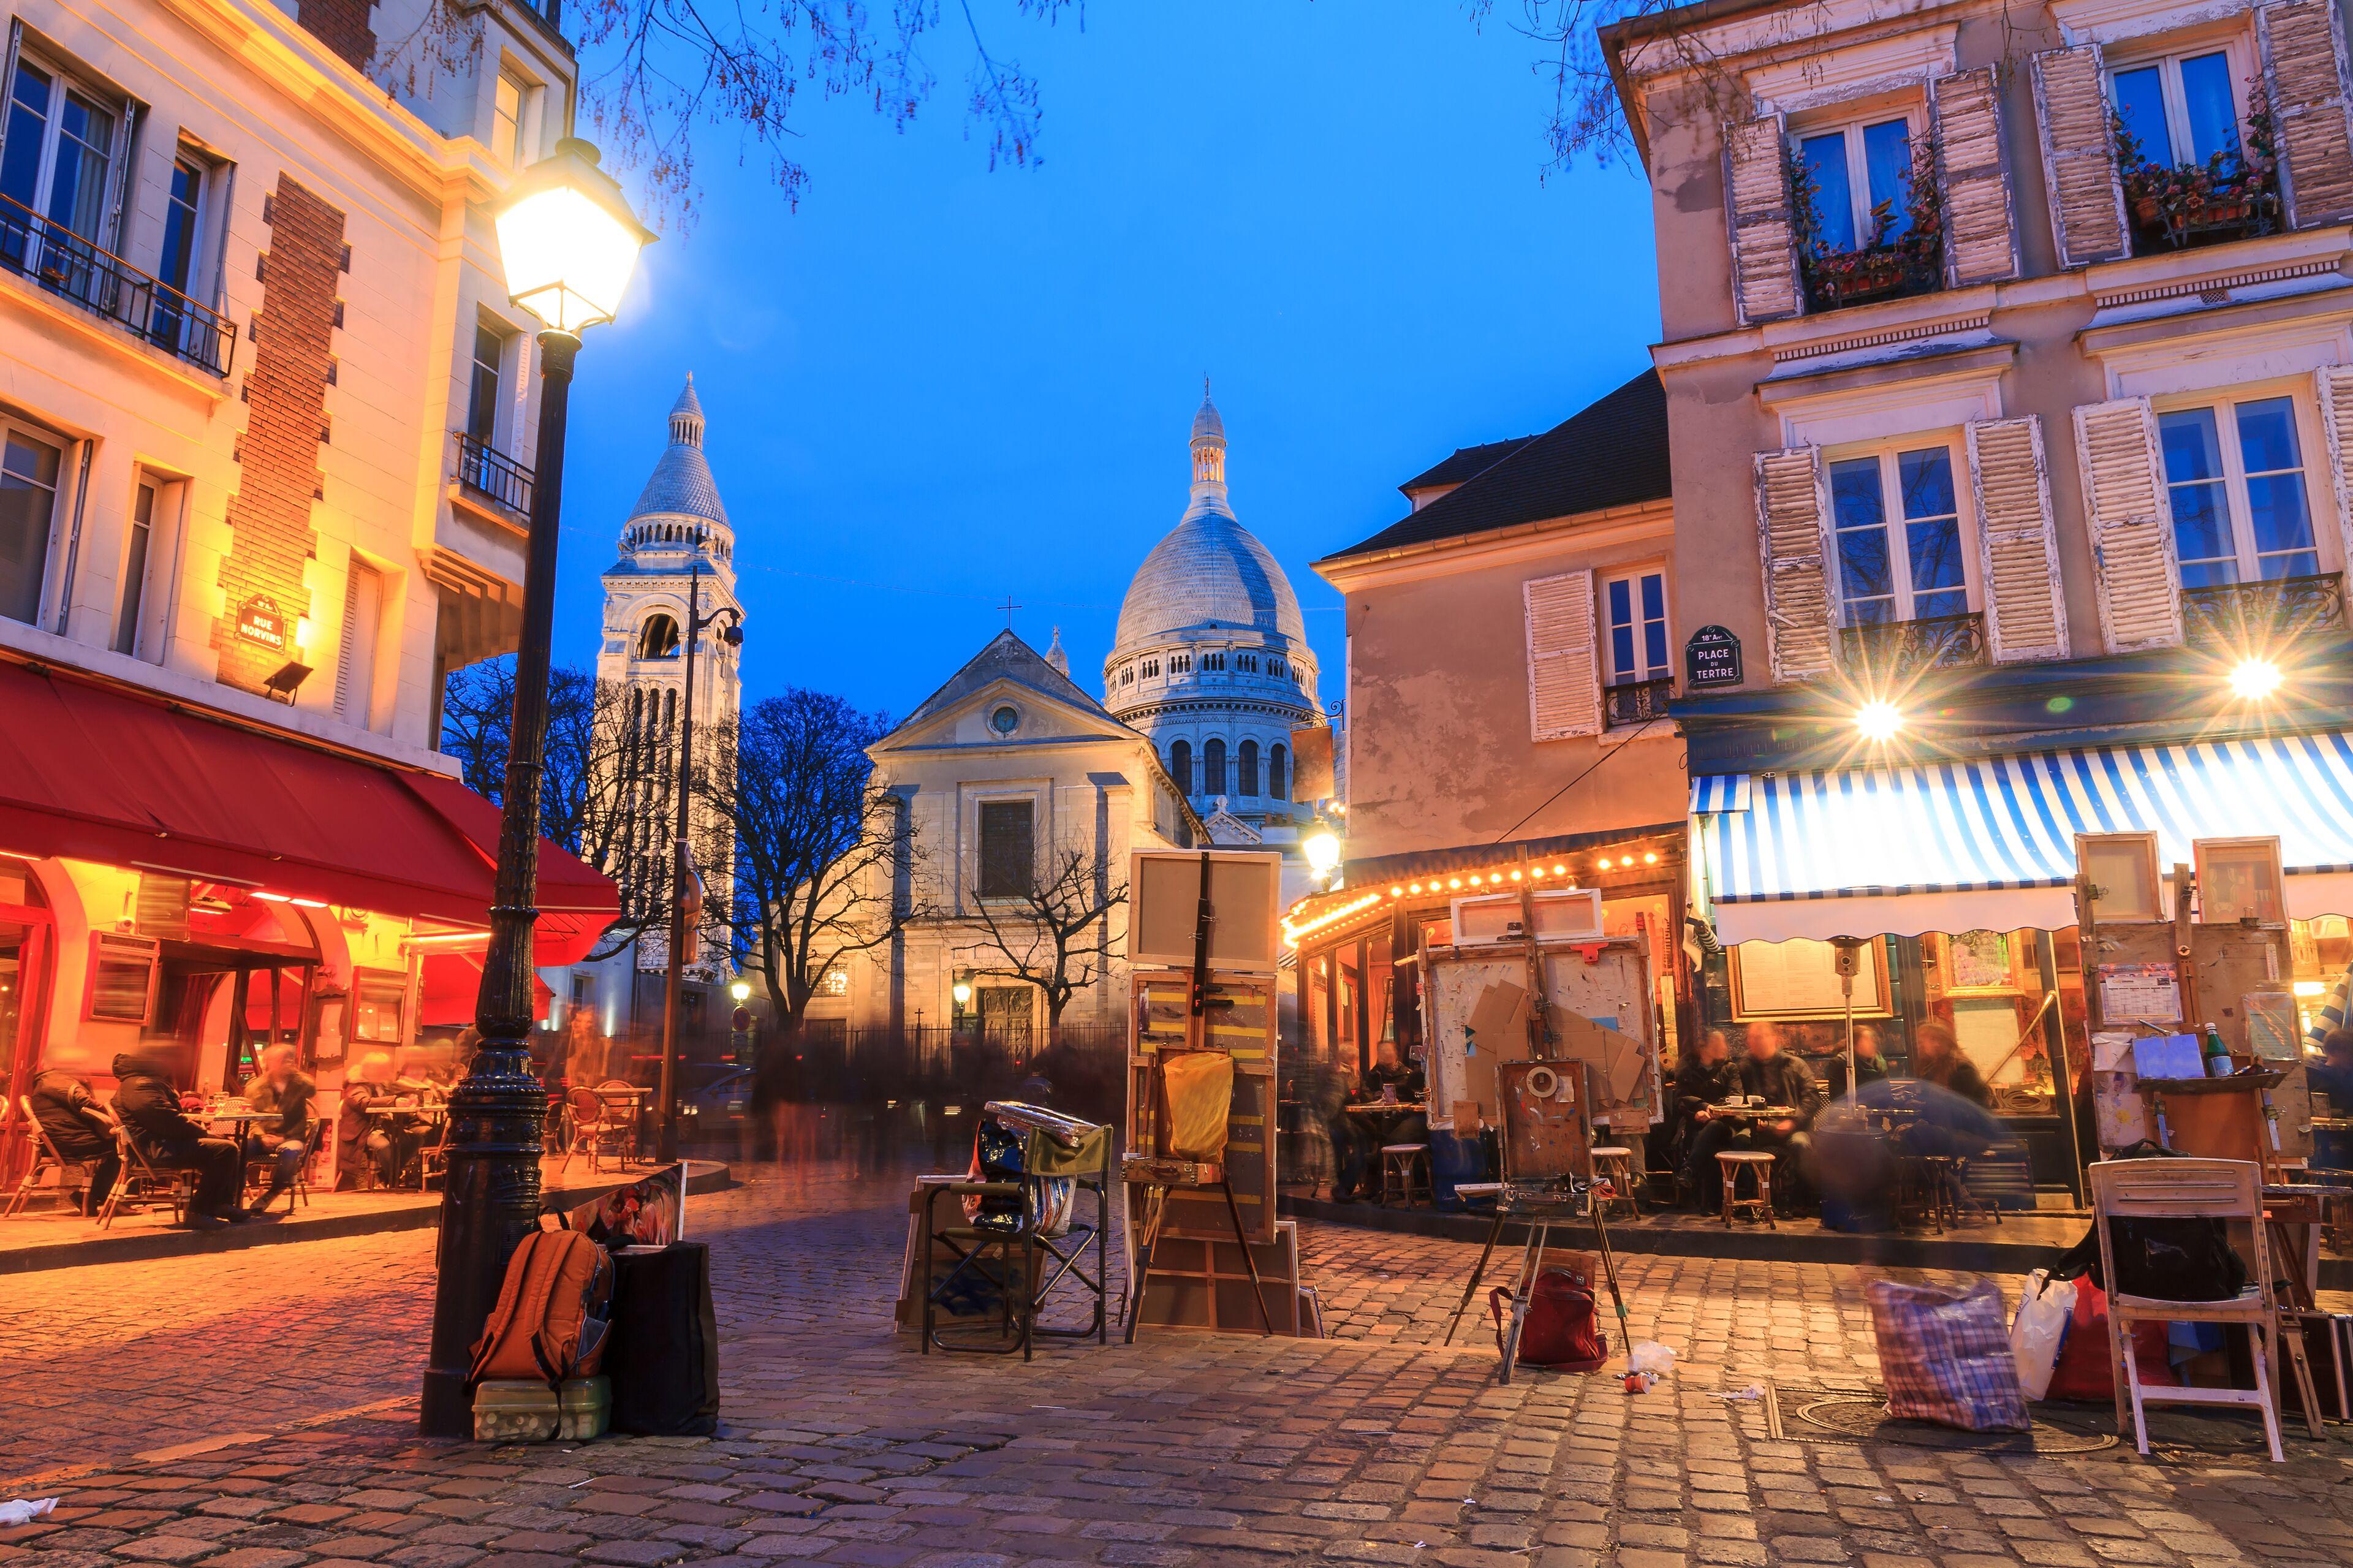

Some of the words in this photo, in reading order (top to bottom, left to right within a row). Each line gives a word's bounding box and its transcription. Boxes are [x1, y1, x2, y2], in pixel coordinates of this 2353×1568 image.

[253, 615, 273, 631] RUE
[240, 623, 282, 646] NORVINS
[1698, 649, 1729, 660] PLACE
[1696, 667, 1733, 679] TERTRE
